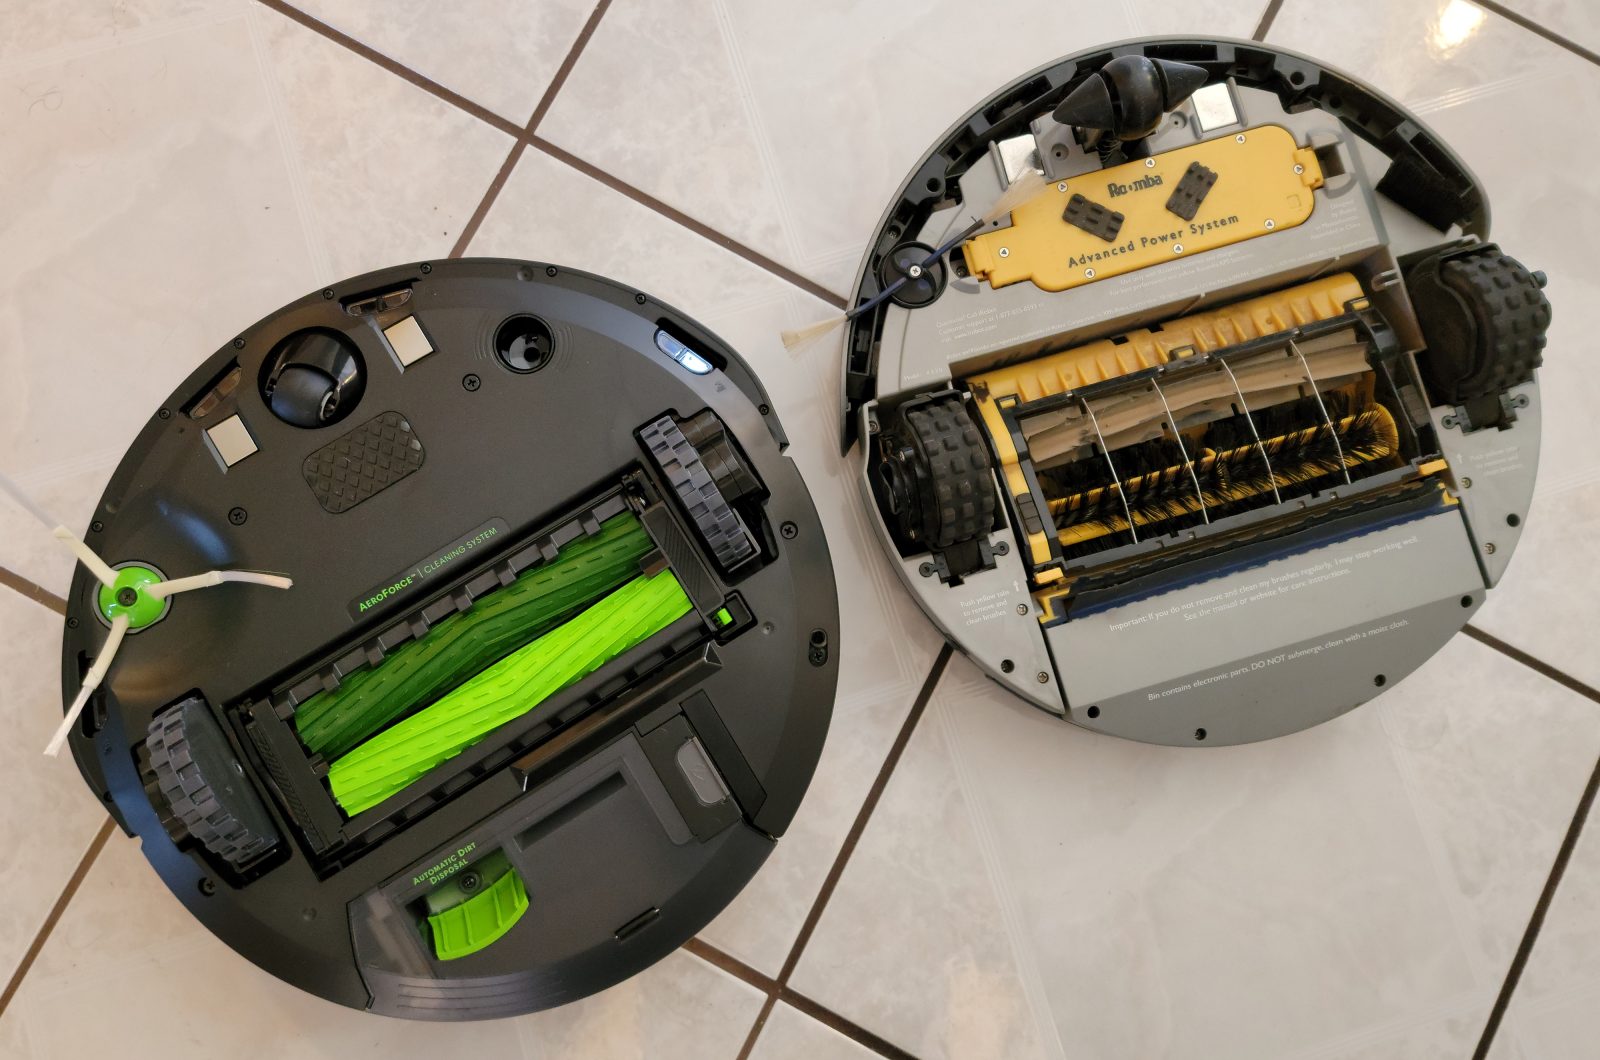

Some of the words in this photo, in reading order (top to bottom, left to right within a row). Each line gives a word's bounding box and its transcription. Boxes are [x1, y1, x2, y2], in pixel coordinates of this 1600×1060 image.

[1069, 242, 1135, 268] Advanced
[1141, 230, 1184, 247] Power
[1190, 215, 1239, 235] System
[423, 545, 466, 574] CLEANING
[466, 527, 498, 549] SYSTEM
[1110, 617, 1146, 631] Important:
[1155, 611, 1169, 621] you
[1182, 602, 1194, 610] not
[1197, 596, 1222, 607] remove
[1225, 589, 1238, 598] and
[1240, 584, 1258, 594] clean
[1260, 580, 1270, 588] my
[1272, 572, 1300, 584] brushes
[1340, 555, 1354, 564] may
[1356, 551, 1371, 560] stop
[1373, 541, 1402, 555] working
[1184, 612, 1197, 621] See
[1200, 609, 1211, 617] the
[1213, 601, 1237, 613] manual
[1148, 692, 1160, 701] Bin
[1162, 684, 1192, 697] contains
[1193, 673, 1229, 688] electronic
[1230, 667, 1250, 678] parts.
[1251, 661, 1266, 670] DO
[1267, 655, 1286, 666] NOT
[1325, 639, 1343, 649] clean
[1346, 633, 1361, 643] with
[1368, 626, 1388, 636] moist
[413, 855, 457, 886] AUTOMATIC
[457, 842, 477, 857] DIRT
[430, 859, 468, 885] DISPOSAL
